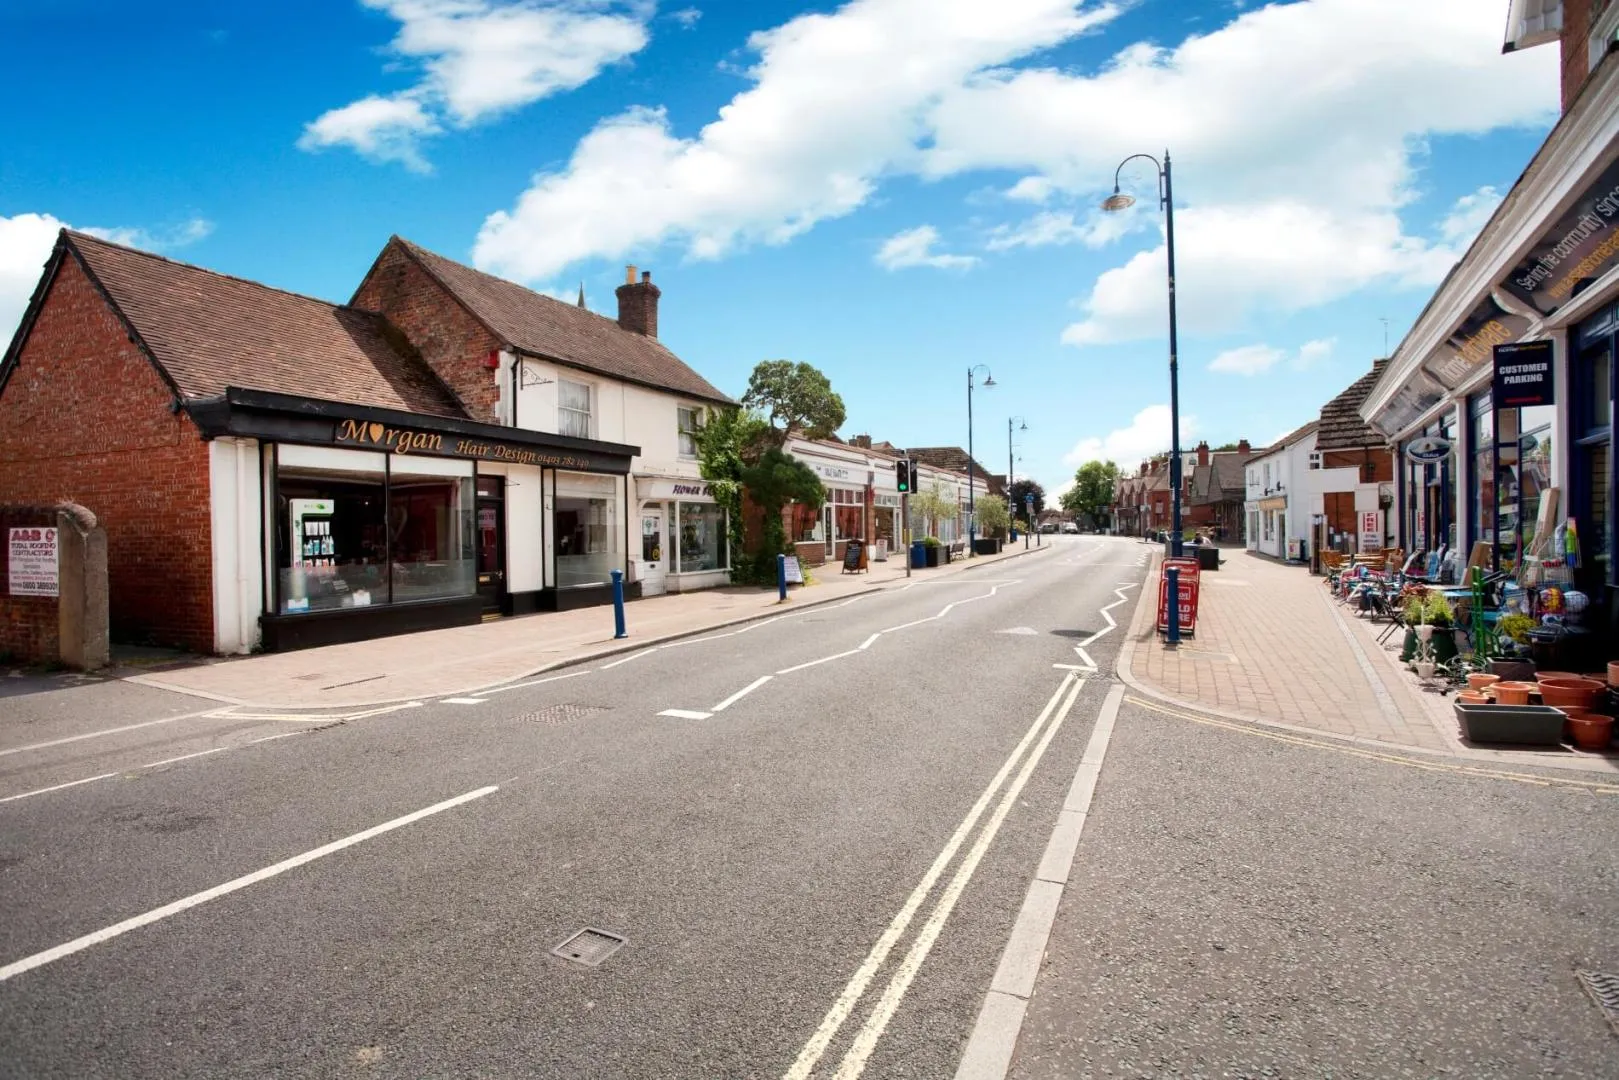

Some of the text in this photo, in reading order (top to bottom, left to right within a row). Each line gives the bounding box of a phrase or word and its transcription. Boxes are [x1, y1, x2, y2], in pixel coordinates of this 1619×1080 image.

[1516, 264, 1553, 291] Serving
[1538, 254, 1560, 271] the
[1552, 211, 1607, 258] community
[1499, 362, 1548, 375] CUSTOMER
[1504, 373, 1543, 385] PARKING
[454, 439, 490, 455] Hair
[494, 444, 535, 464] Design
[672, 484, 700, 495] FLOWER
[1164, 604, 1190, 613] SLD
